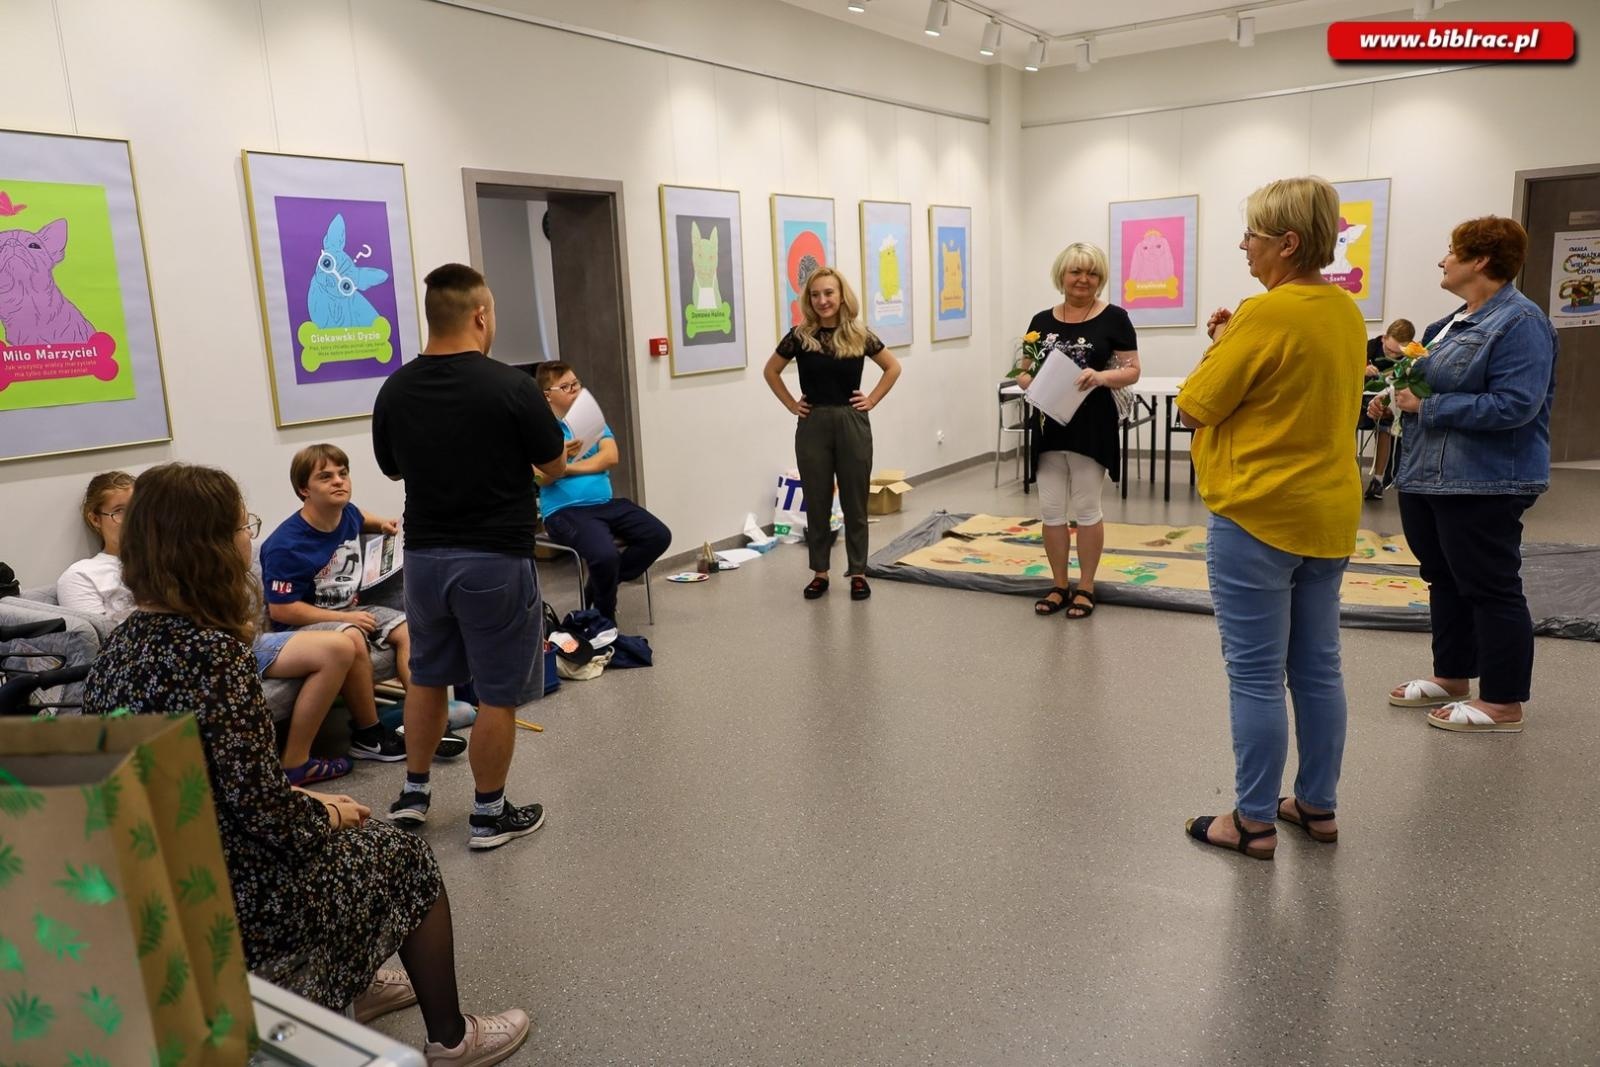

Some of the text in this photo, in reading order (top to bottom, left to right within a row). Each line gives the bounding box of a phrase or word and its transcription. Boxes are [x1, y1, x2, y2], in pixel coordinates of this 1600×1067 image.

[2, 347, 98, 362] Milo Marzyciel
[271, 580, 293, 593] NYC
